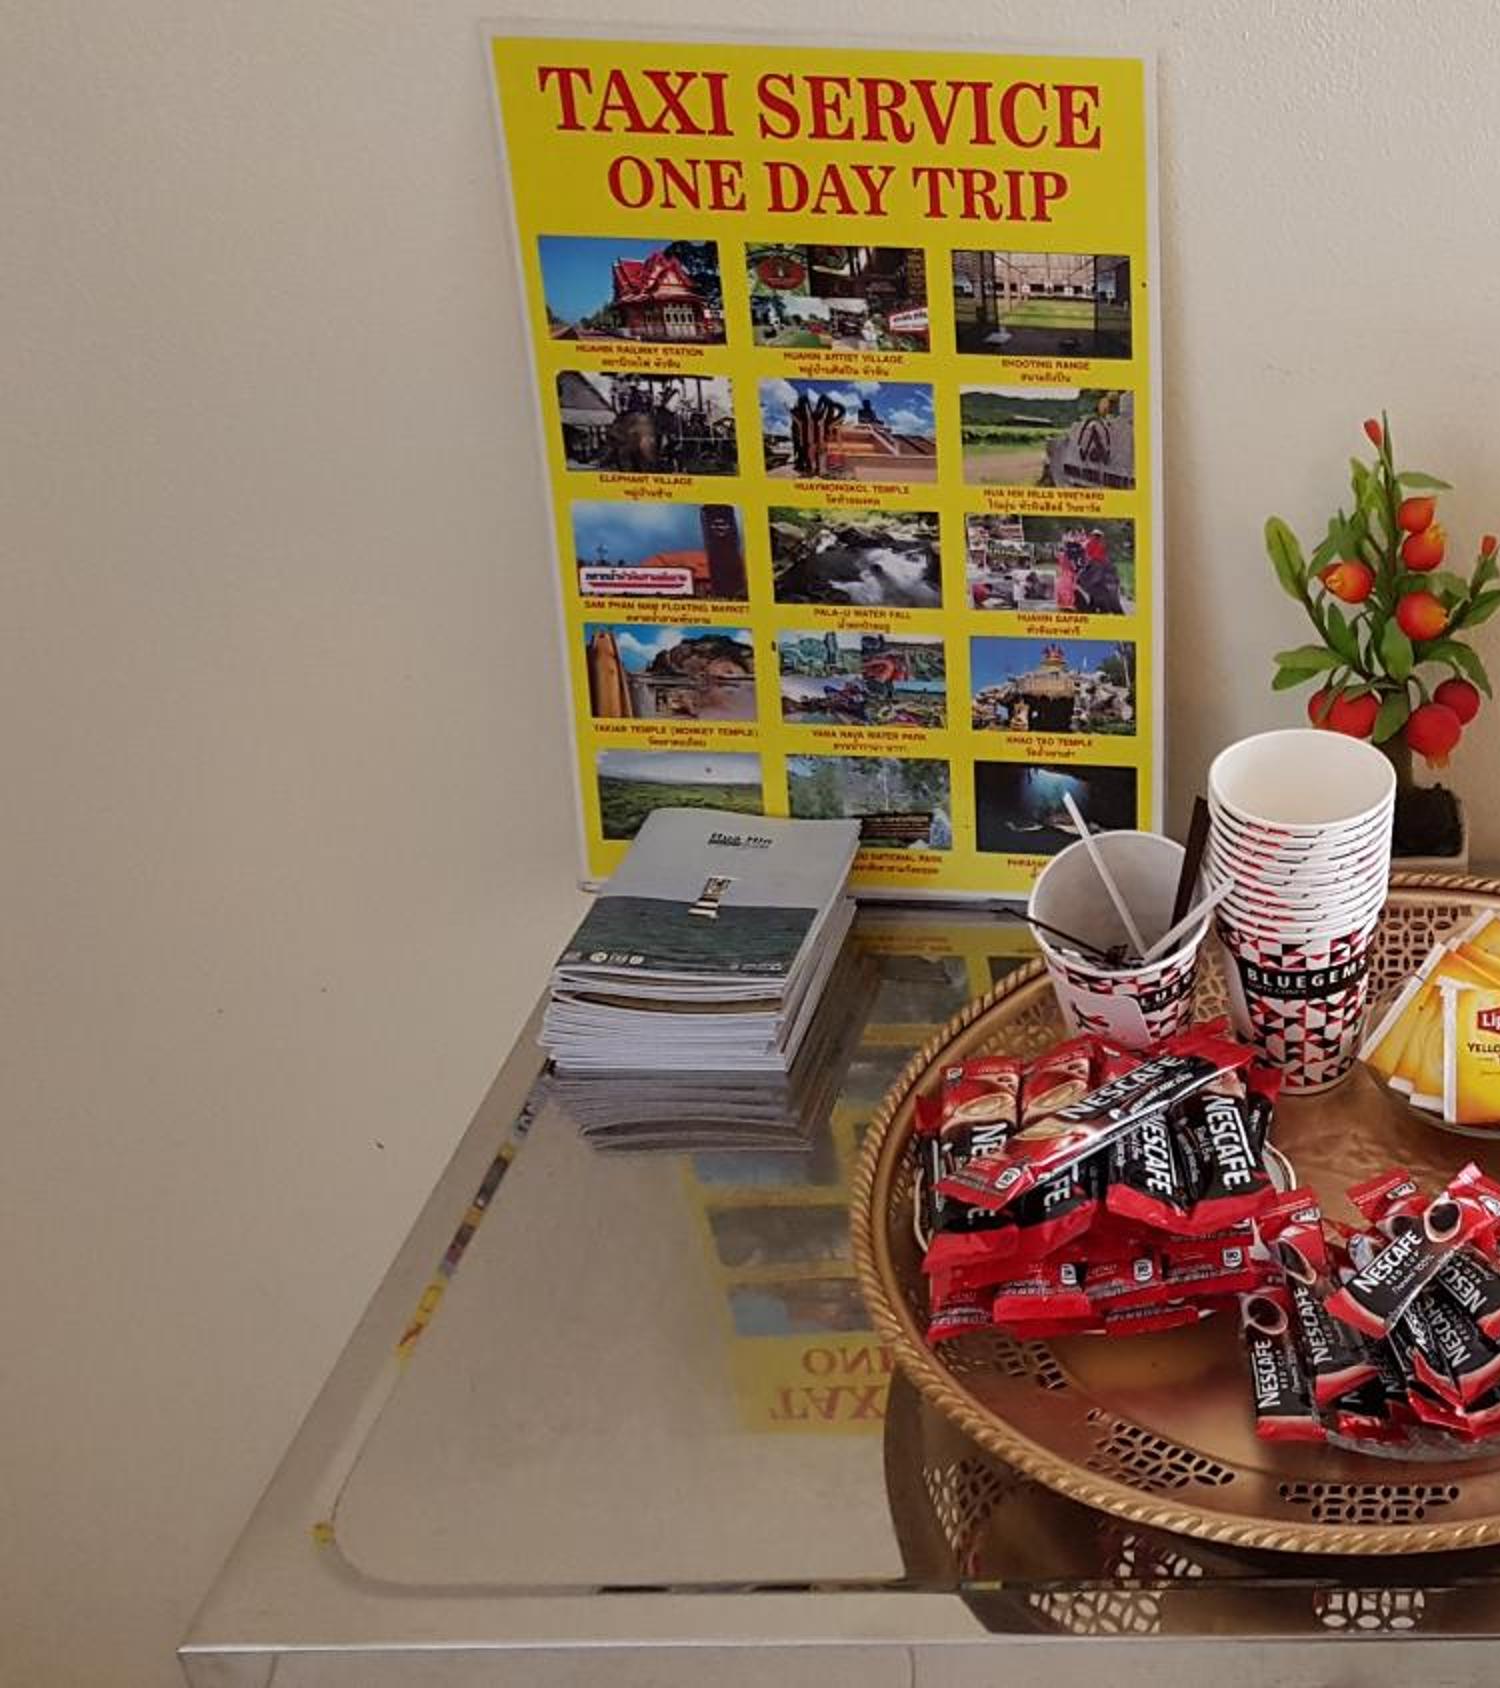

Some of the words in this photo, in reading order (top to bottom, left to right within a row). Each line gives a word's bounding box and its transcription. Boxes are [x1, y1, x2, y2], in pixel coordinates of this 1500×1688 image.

[538, 66, 733, 137] TAXI
[757, 73, 1102, 149] SERVICE
[608, 155, 747, 211] ONE
[766, 161, 895, 217] DAY
[913, 167, 1068, 222] TRIP
[661, 347, 704, 356] STATION
[862, 354, 903, 364] VILLAGE
[1001, 359, 1053, 369] SHOOTING
[1055, 361, 1089, 370] RANGE
[599, 474, 648, 483] ELEPHANT
[651, 476, 692, 485] VILLAGE
[584, 601, 605, 609] SAM
[661, 603, 709, 613] FLOATING
[711, 605, 750, 615] MARKET
[630, 725, 667, 735] TEMPLE
[1246, 956, 1367, 989] BLUEGEMS
